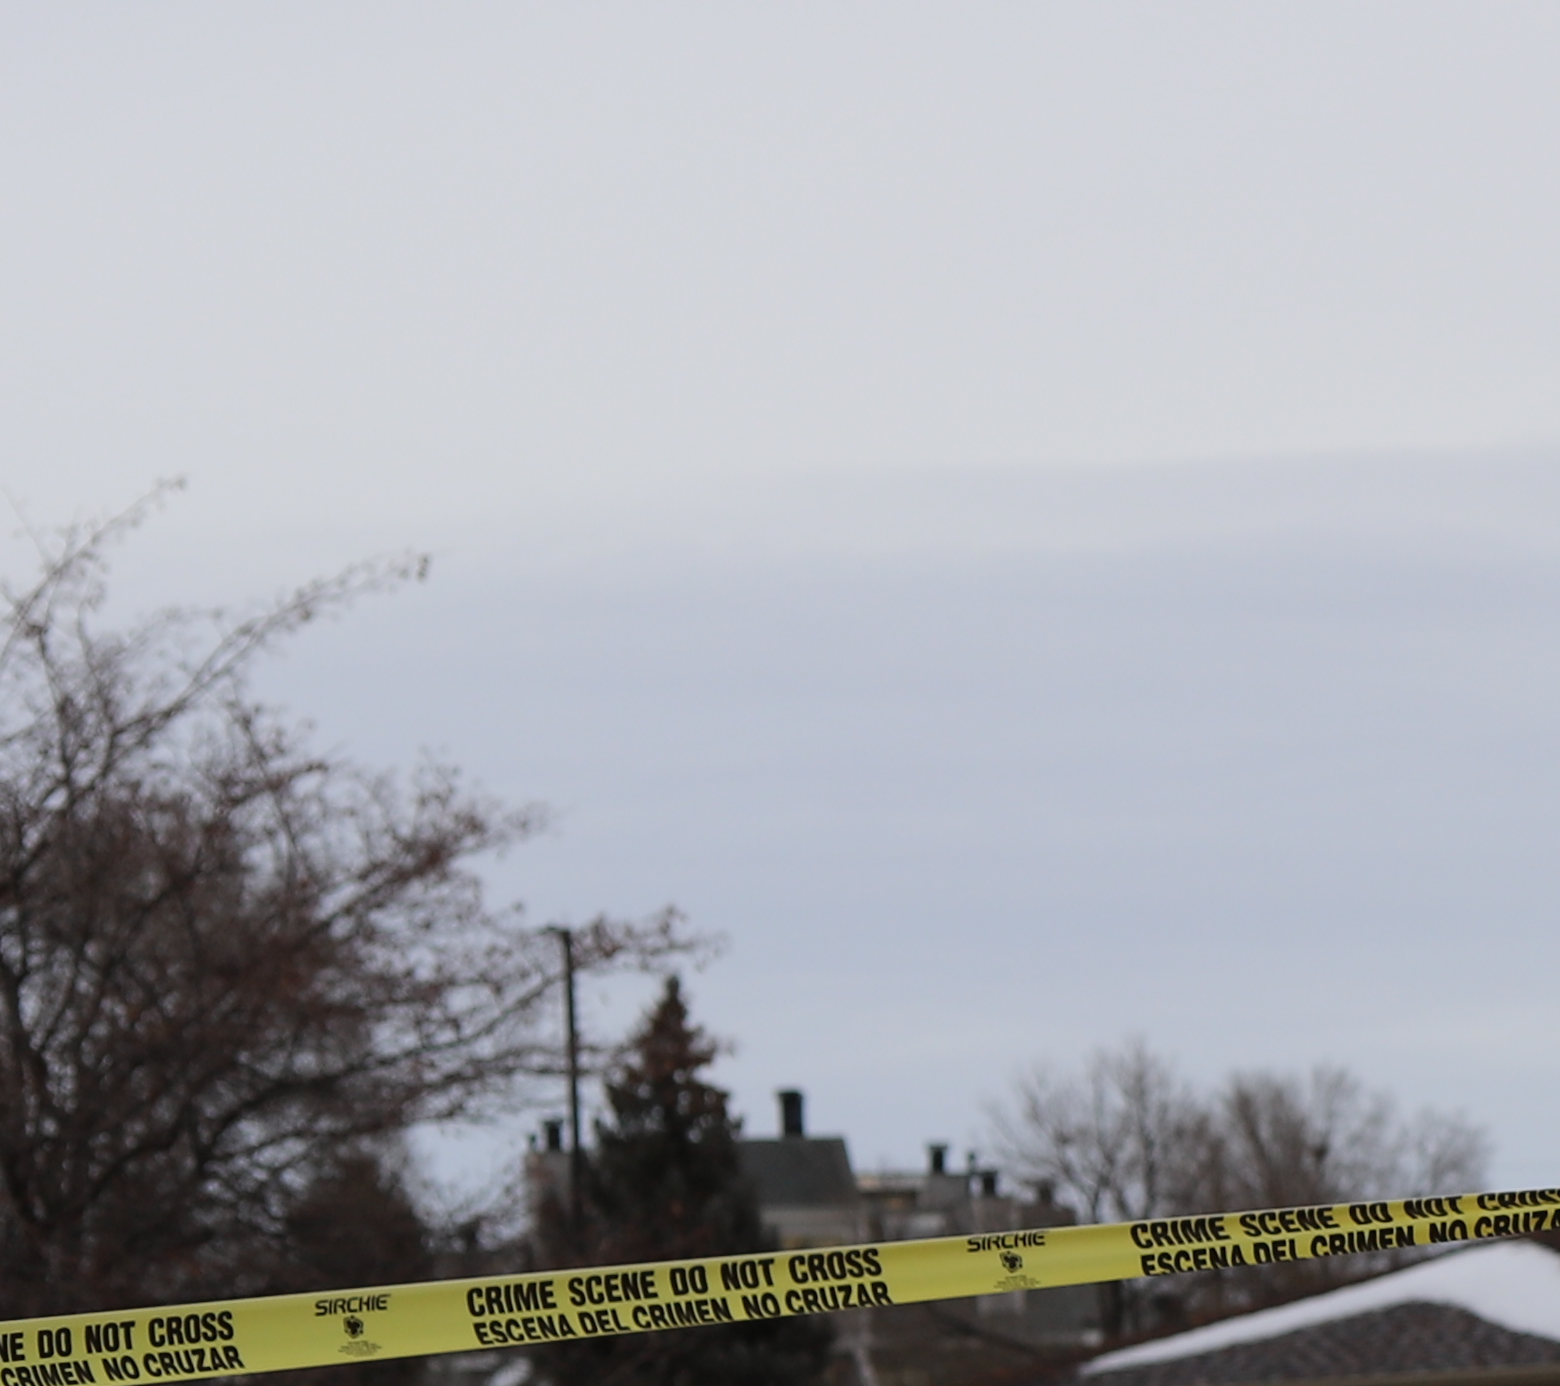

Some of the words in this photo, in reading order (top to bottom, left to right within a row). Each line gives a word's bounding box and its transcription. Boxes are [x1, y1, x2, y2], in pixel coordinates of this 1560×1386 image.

[966, 1230, 1047, 1252] SIRCHIE
[1130, 1216, 1231, 1249] CRIME
[1240, 1206, 1339, 1237] SCENE
[1348, 1202, 1393, 1225] DO
[1403, 1196, 1464, 1219] NOT
[1140, 1243, 1248, 1276] ESCENA
[1253, 1238, 1306, 1264] DEL
[1310, 1225, 1416, 1258] CRIMEN
[1429, 1219, 1468, 1243] NO
[315, 1294, 391, 1317] SIRCHIE
[466, 1280, 557, 1317] CRIME
[568, 1270, 658, 1306] SCENE
[669, 1265, 708, 1296] DO
[720, 1258, 775, 1291] NOT
[788, 1248, 882, 1284] CROSS
[37, 1327, 72, 1359] DO
[85, 1320, 136, 1354] NOT
[148, 1310, 234, 1347] CROSS
[472, 1314, 577, 1345] ESCENA
[577, 1308, 630, 1336] DEL
[632, 1297, 734, 1330] CRIMEN
[741, 1292, 780, 1319] NO
[785, 1281, 894, 1313] CRUZAR
[102, 1355, 140, 1381] NO
[143, 1345, 246, 1377] CRUZAR
